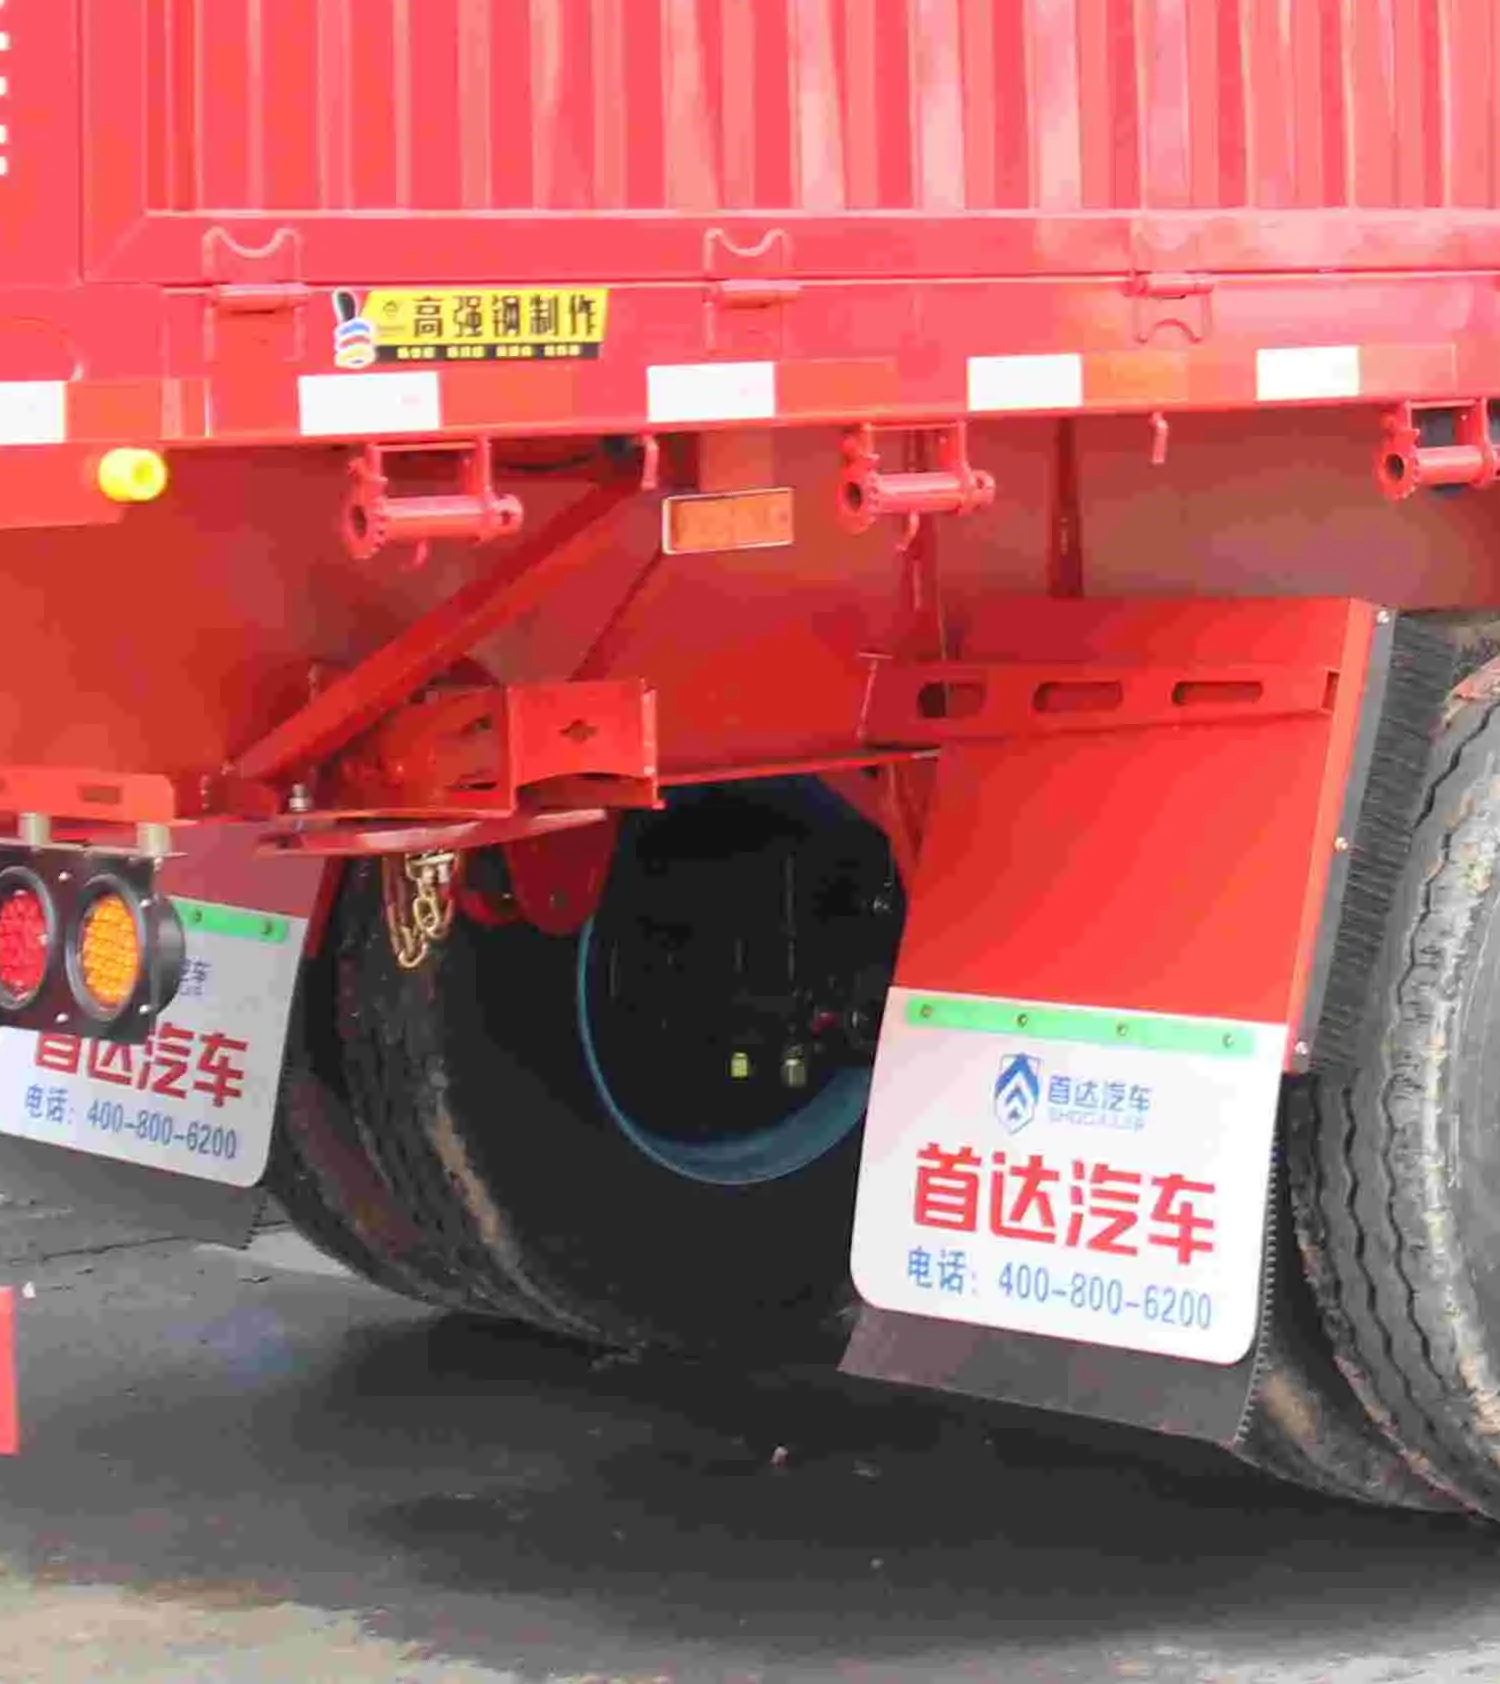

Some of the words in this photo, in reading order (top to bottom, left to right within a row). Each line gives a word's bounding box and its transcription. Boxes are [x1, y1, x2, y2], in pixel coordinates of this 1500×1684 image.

[1046, 1075, 1153, 1113] 首达汽车
[86, 1099, 237, 1159] 400-800-6200
[912, 1142, 1217, 1266] 首达汽车
[998, 1260, 1213, 1330] 400-800-6200
